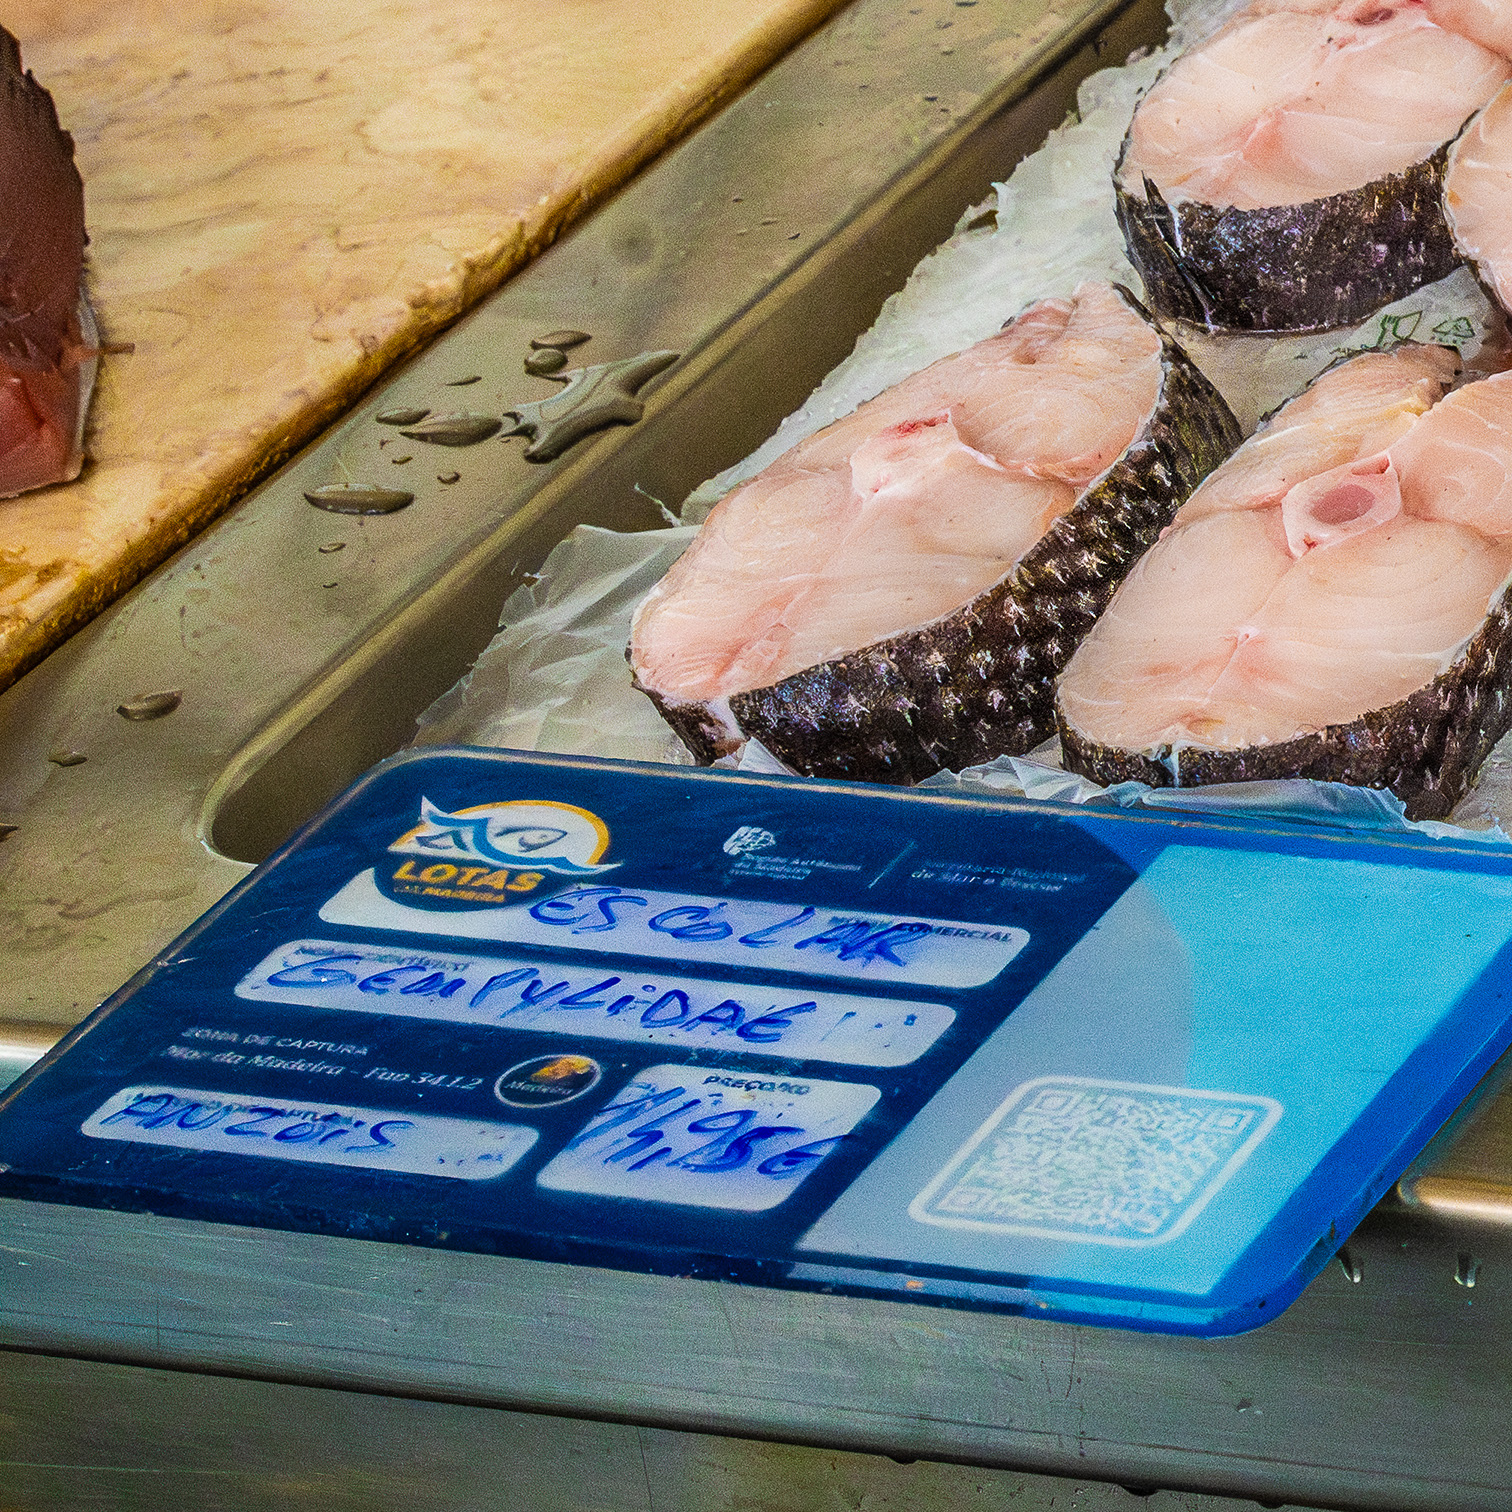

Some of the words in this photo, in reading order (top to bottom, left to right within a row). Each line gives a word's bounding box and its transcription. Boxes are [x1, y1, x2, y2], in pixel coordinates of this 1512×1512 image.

[393, 860, 545, 892] LOTAS
[276, 1038, 369, 1056] CAPTURA
[248, 1055, 346, 1076] Madeira
